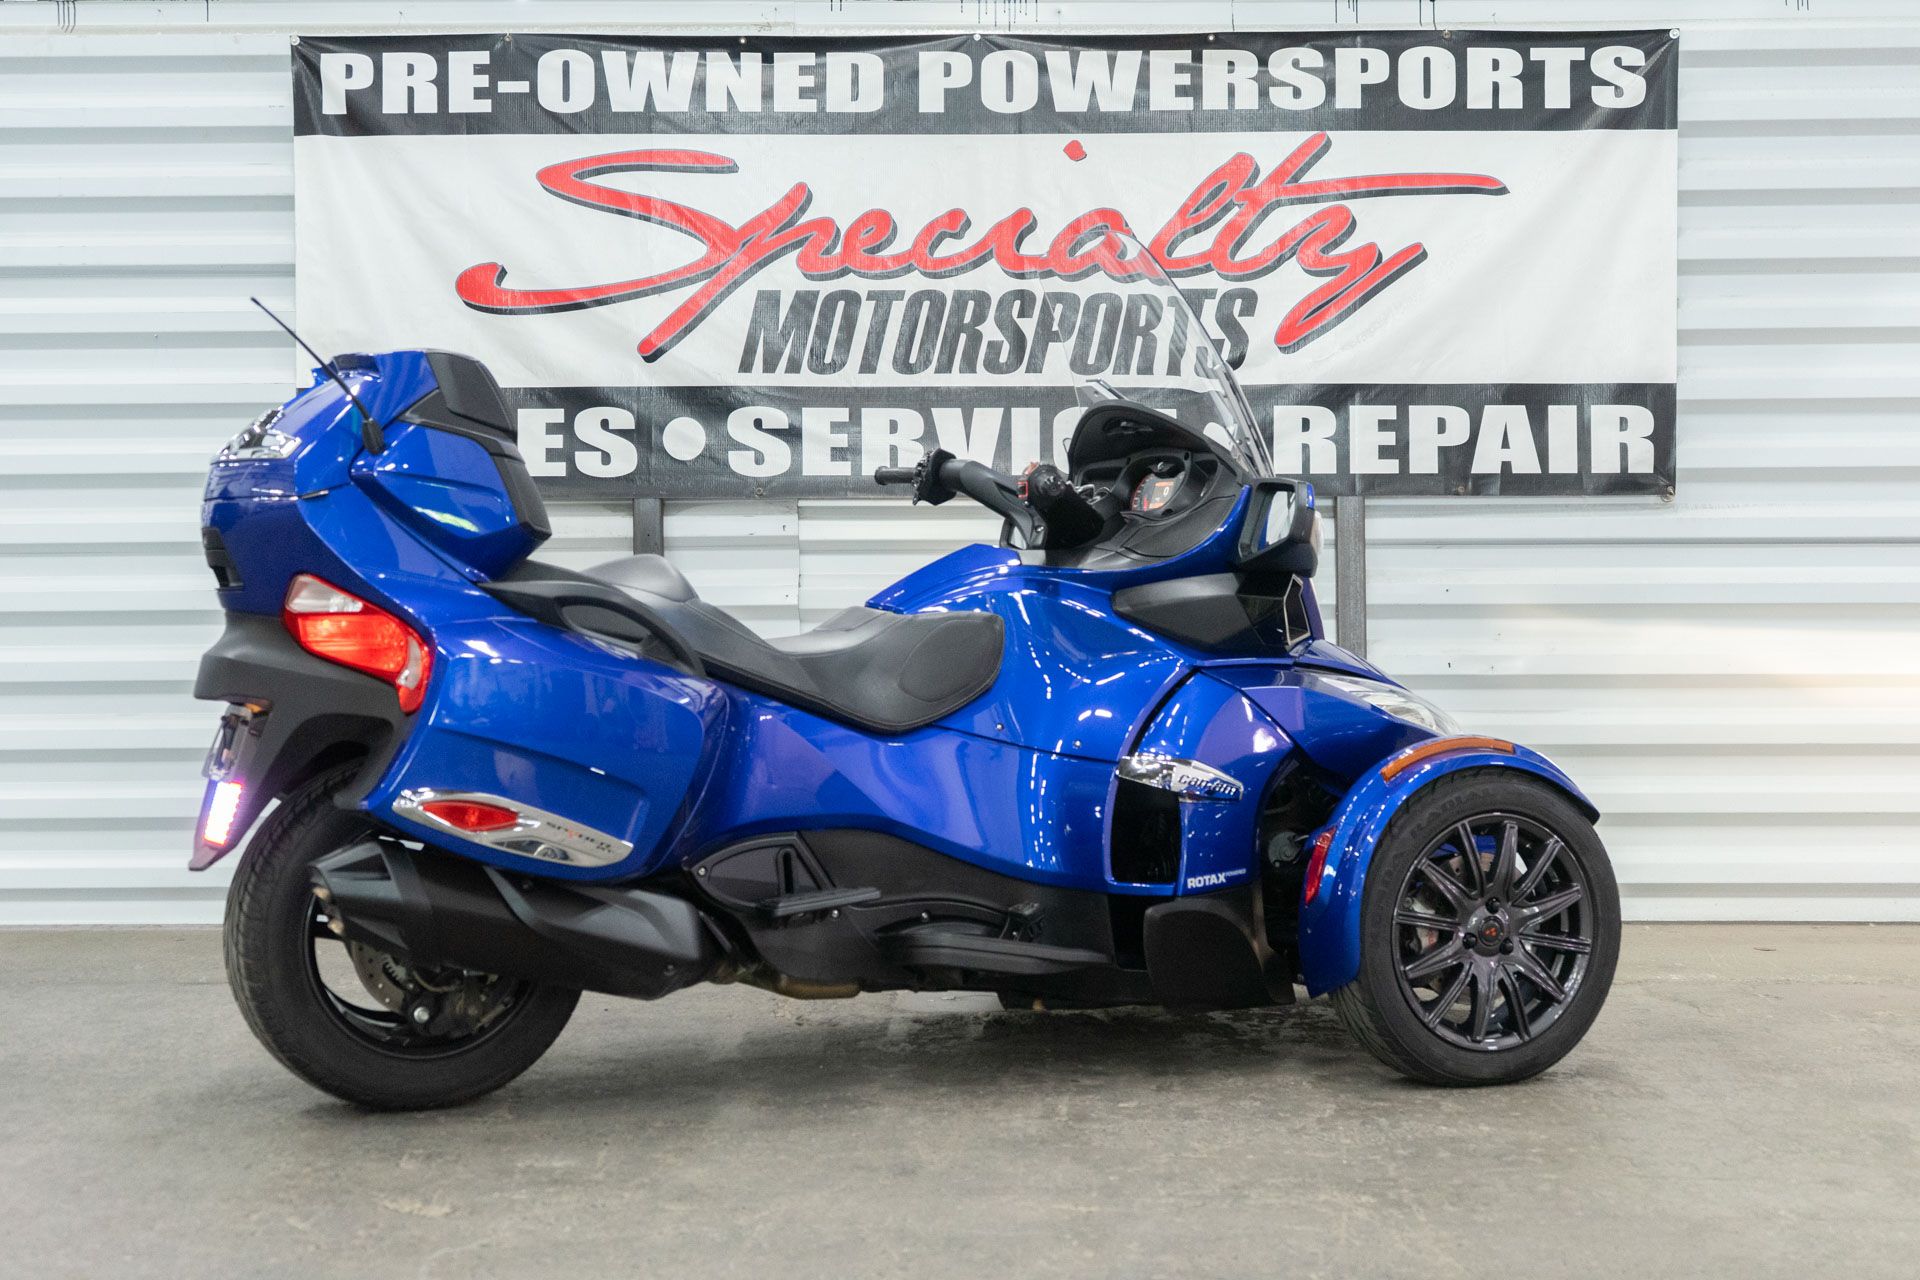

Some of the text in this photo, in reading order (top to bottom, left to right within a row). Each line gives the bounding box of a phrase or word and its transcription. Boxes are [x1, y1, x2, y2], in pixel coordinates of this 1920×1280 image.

[319, 45, 1648, 115] PRE-OWNED POWERSPORTS
[455, 132, 1511, 364] Specialty
[737, 287, 1259, 377] MOTORSPORTS
[726, 404, 1656, 478] SERVI REPAIR
[1186, 872, 1227, 889] ROTAX
